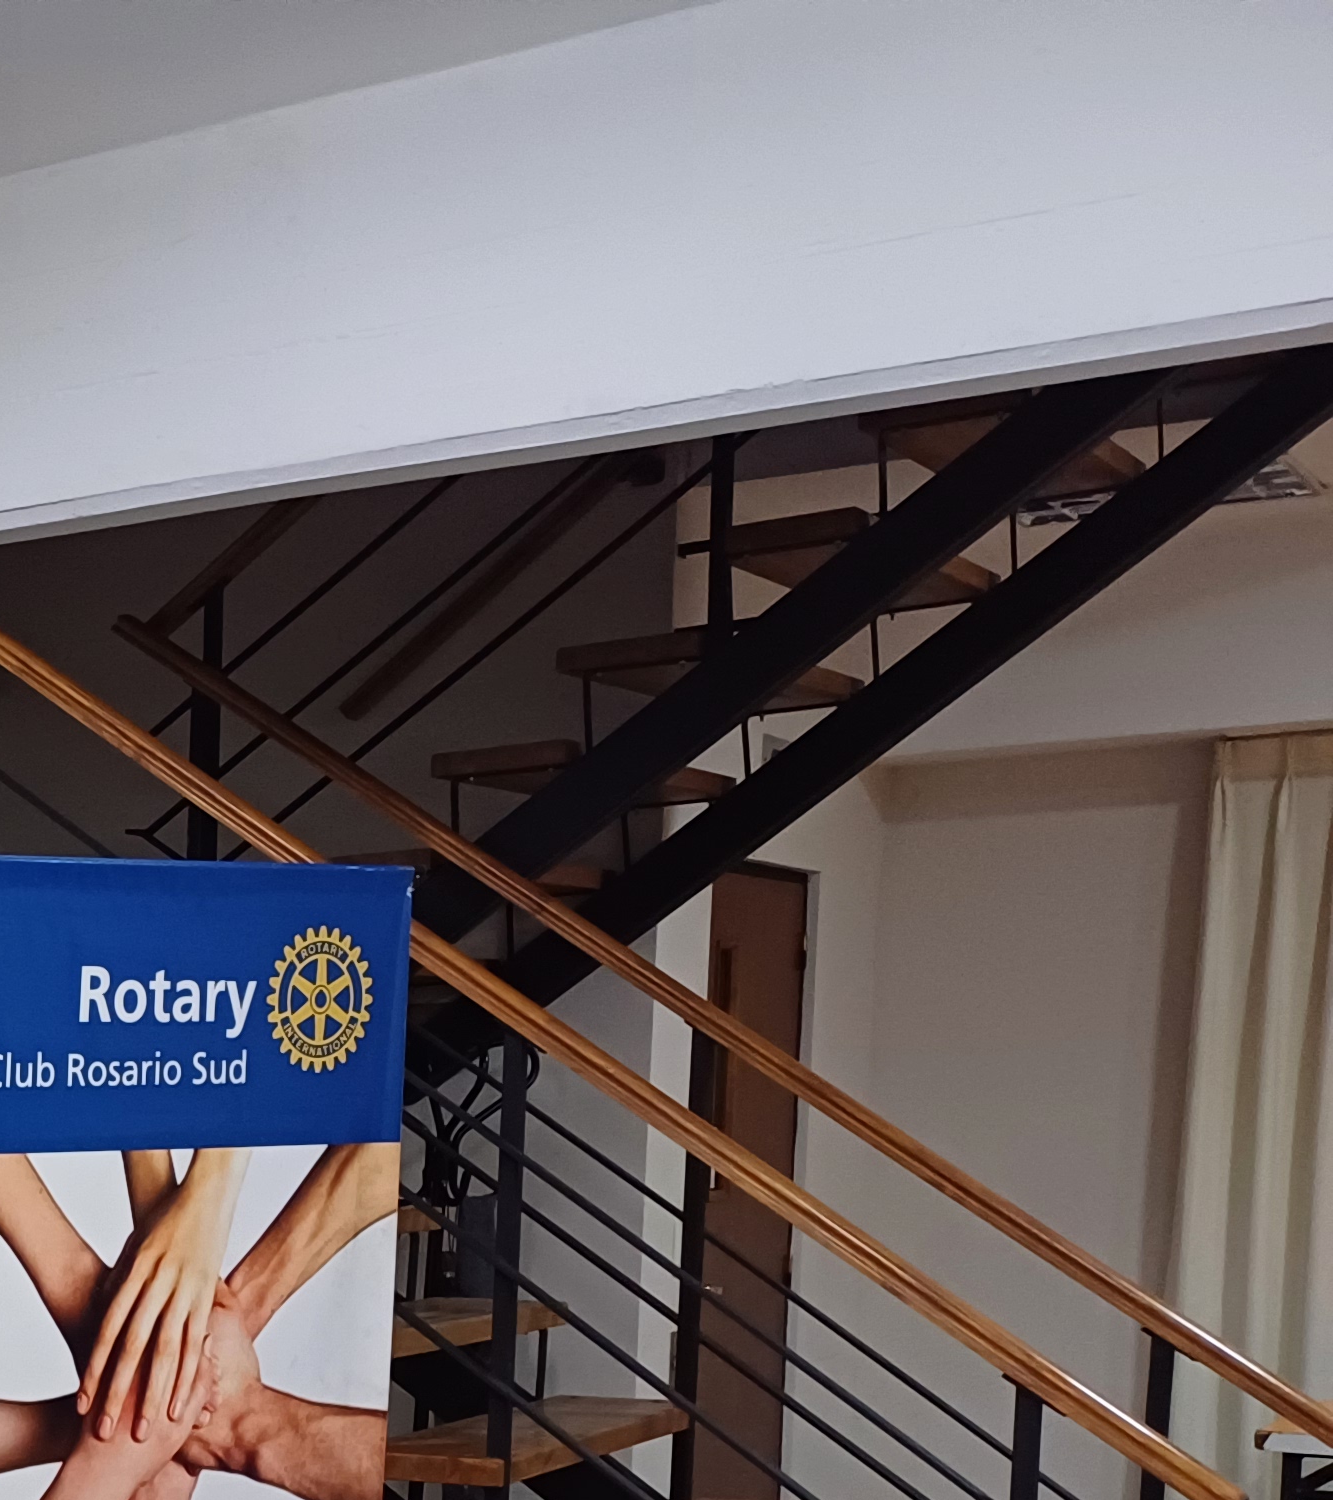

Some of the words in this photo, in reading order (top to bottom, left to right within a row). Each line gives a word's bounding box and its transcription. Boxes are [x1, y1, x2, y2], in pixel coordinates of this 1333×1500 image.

[300, 942, 344, 960] ROTARY
[78, 965, 257, 1039] Rotary
[282, 1021, 358, 1057] INTERNATIONAL
[67, 1051, 182, 1087] Rosario
[192, 1049, 248, 1085] Sud
